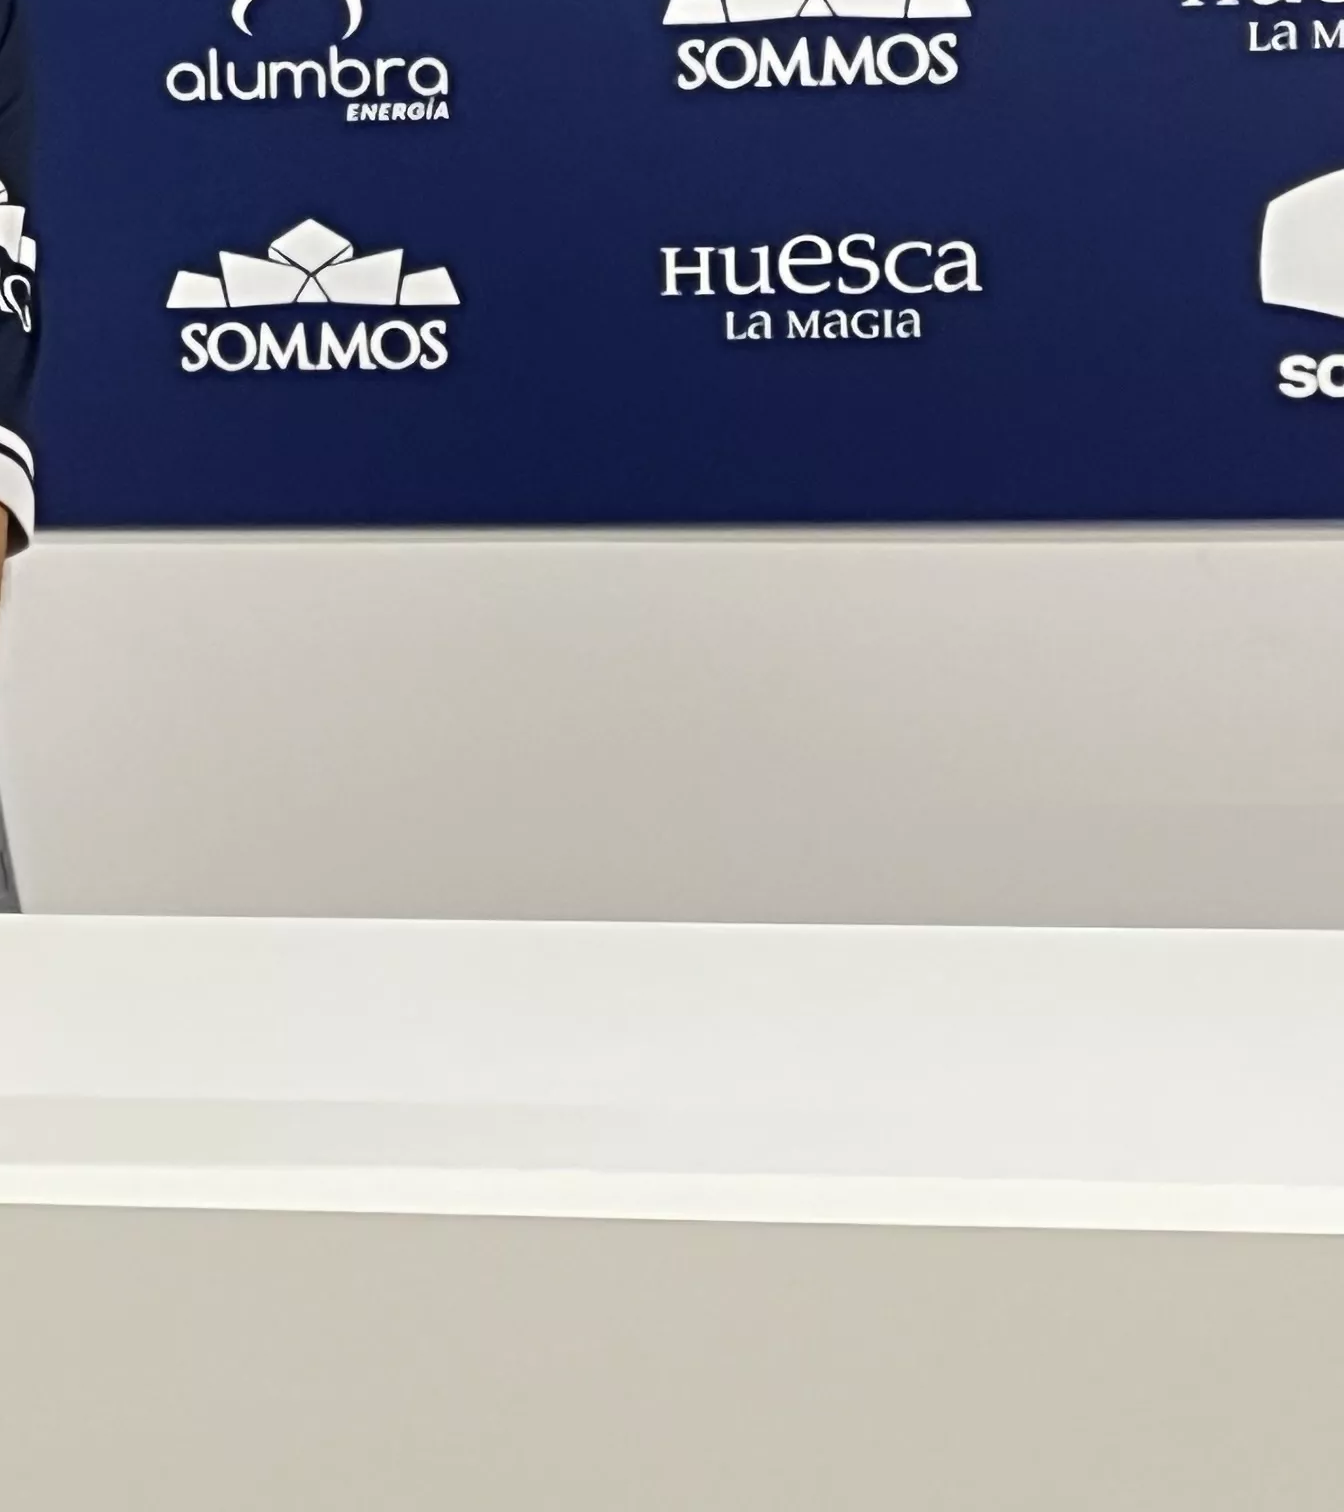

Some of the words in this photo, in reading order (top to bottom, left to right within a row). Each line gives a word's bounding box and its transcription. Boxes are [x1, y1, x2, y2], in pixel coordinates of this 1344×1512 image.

[166, 44, 449, 102] alumbra
[677, 32, 959, 90] SOMMOS
[346, 96, 450, 122] ENERGÍA
[181, 319, 448, 372] SOMMOS
